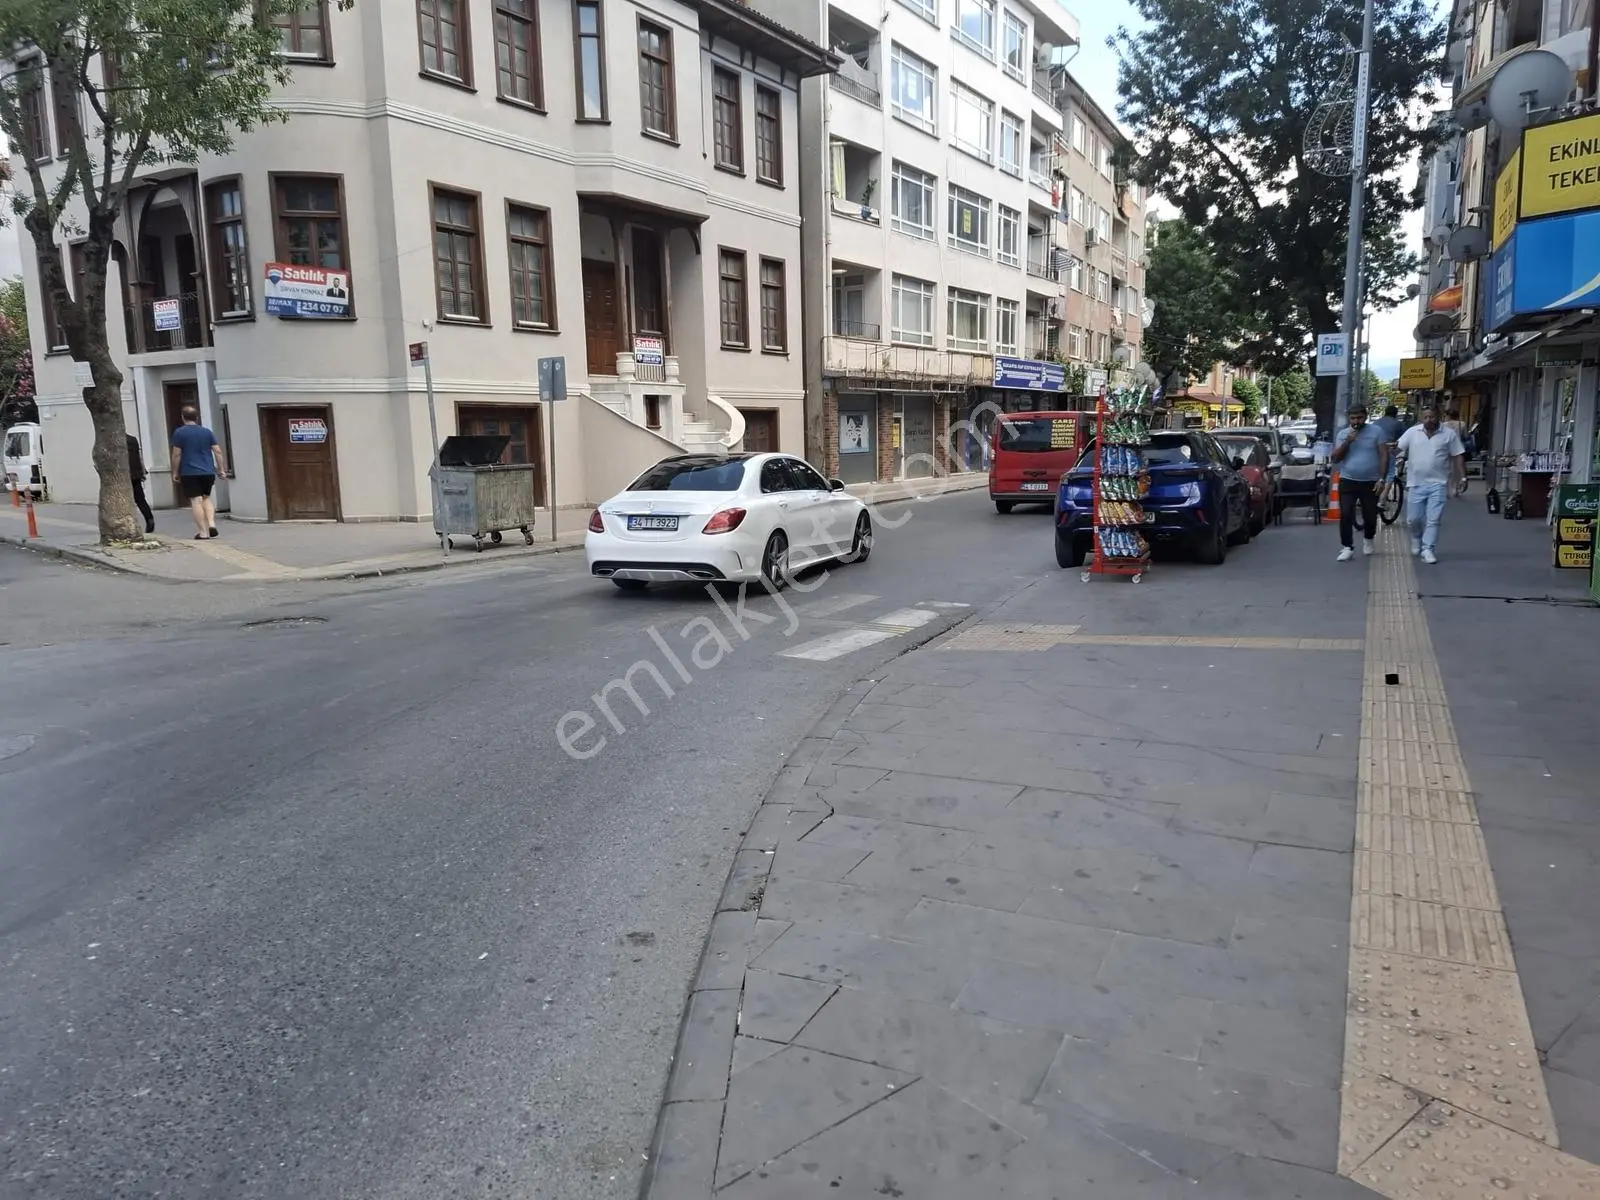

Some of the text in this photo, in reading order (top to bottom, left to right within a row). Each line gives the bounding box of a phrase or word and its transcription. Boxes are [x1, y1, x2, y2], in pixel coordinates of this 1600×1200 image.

[284, 267, 326, 282] Satılık
[1565, 498, 1600, 511] Carlsber
[632, 516, 677, 528] 34 TT 3923
